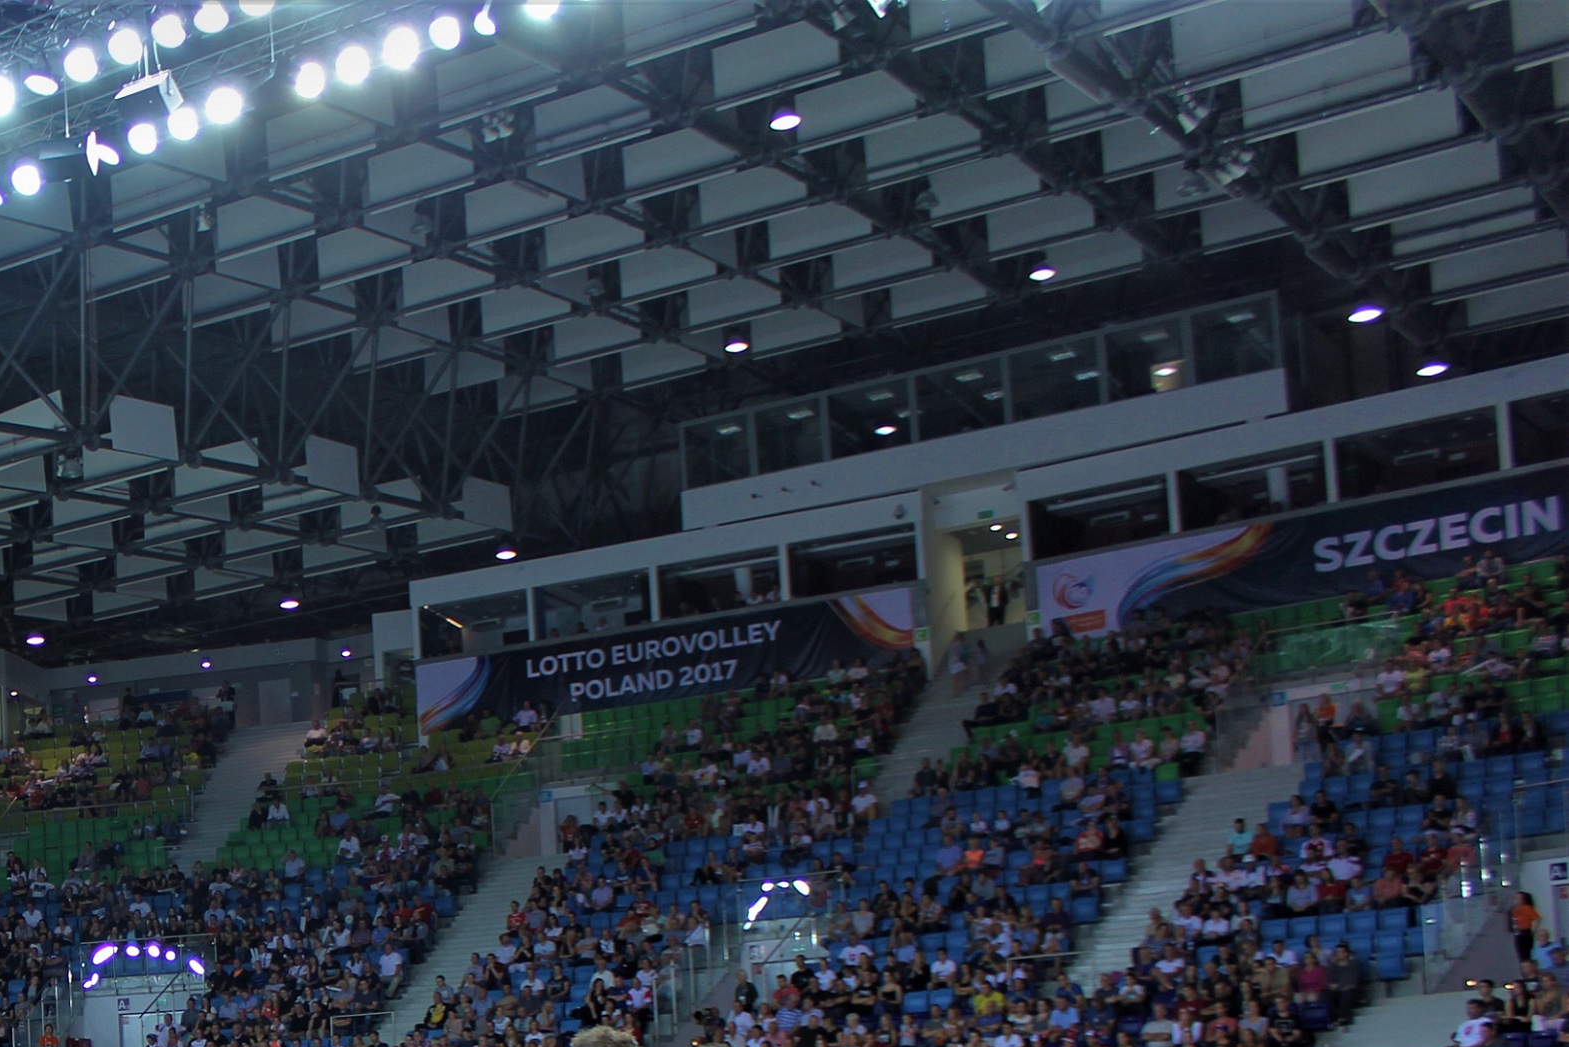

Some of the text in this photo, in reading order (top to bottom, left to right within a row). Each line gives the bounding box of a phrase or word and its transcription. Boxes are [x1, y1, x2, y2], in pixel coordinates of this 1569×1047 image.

[1313, 494, 1563, 573] SZCZECIN
[526, 619, 781, 679] LOTTO EUROVOLLEY
[570, 659, 738, 702] POLAND 2017
